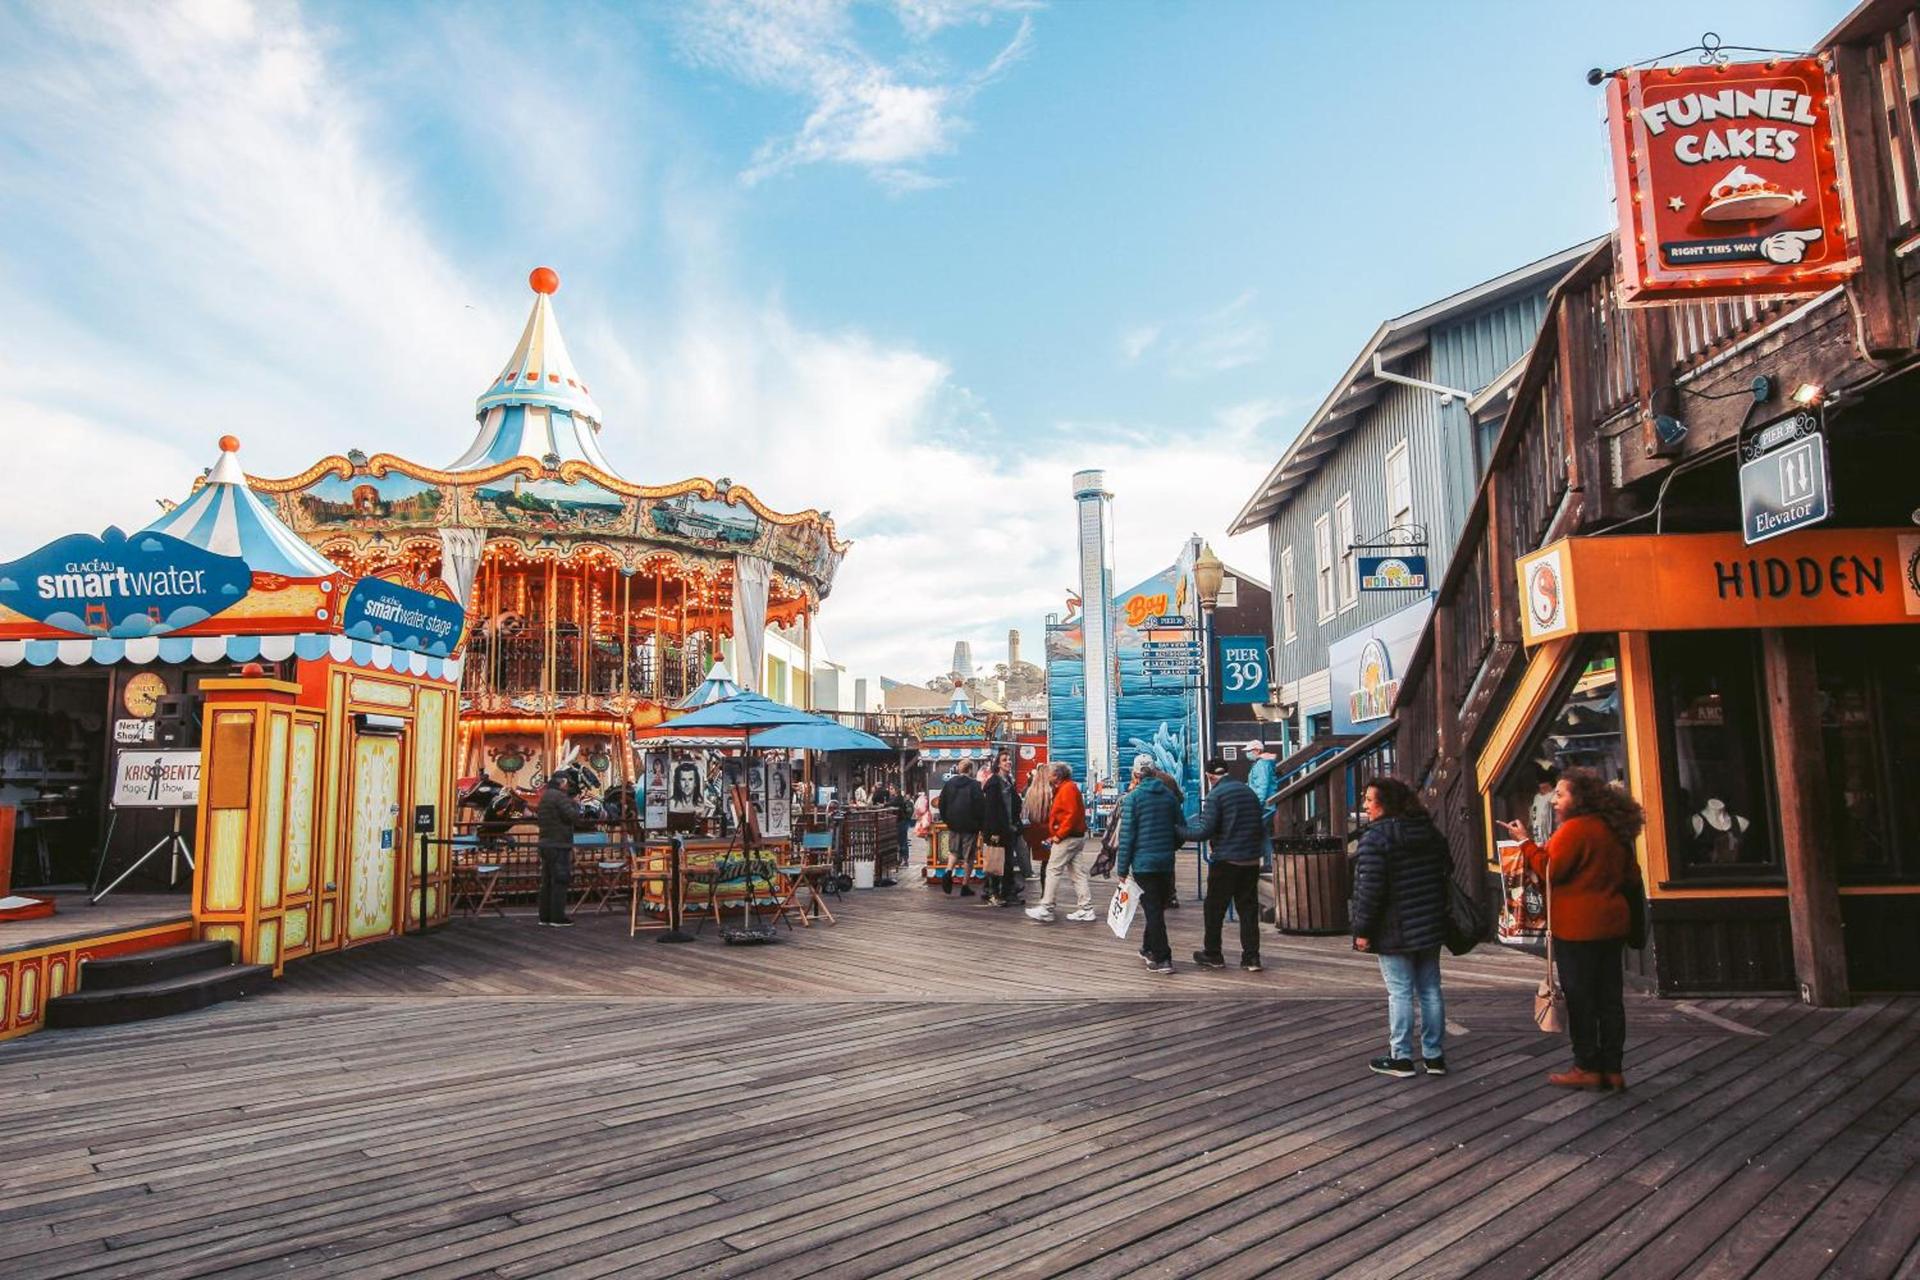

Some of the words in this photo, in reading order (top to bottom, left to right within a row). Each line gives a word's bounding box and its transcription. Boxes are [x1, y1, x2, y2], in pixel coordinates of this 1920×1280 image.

[1640, 89, 1817, 135] FUNNEL
[1674, 127, 1799, 164] CAKES
[1671, 246, 1704, 257] RIGHT
[1706, 244, 1732, 254] THIS
[1733, 243, 1758, 252] WAY
[1762, 426, 1784, 445] PIER
[1784, 421, 1795, 434] 39
[1756, 503, 1812, 533] Elevator
[65, 558, 115, 574] GLACÉAU
[1364, 575, 1423, 588] WORKSHOP
[1714, 555, 1885, 599] HIDDEN
[1125, 594, 1168, 626] Bay
[426, 615, 453, 638] stage
[1226, 648, 1260, 661] PIER
[1226, 662, 1263, 691] 39
[117, 731, 140, 740] Show
[119, 721, 139, 730] Next
[125, 764, 151, 781] KRIS
[162, 764, 201, 781] BENTZ
[122, 783, 148, 795] Magic
[162, 782, 184, 793] Show
